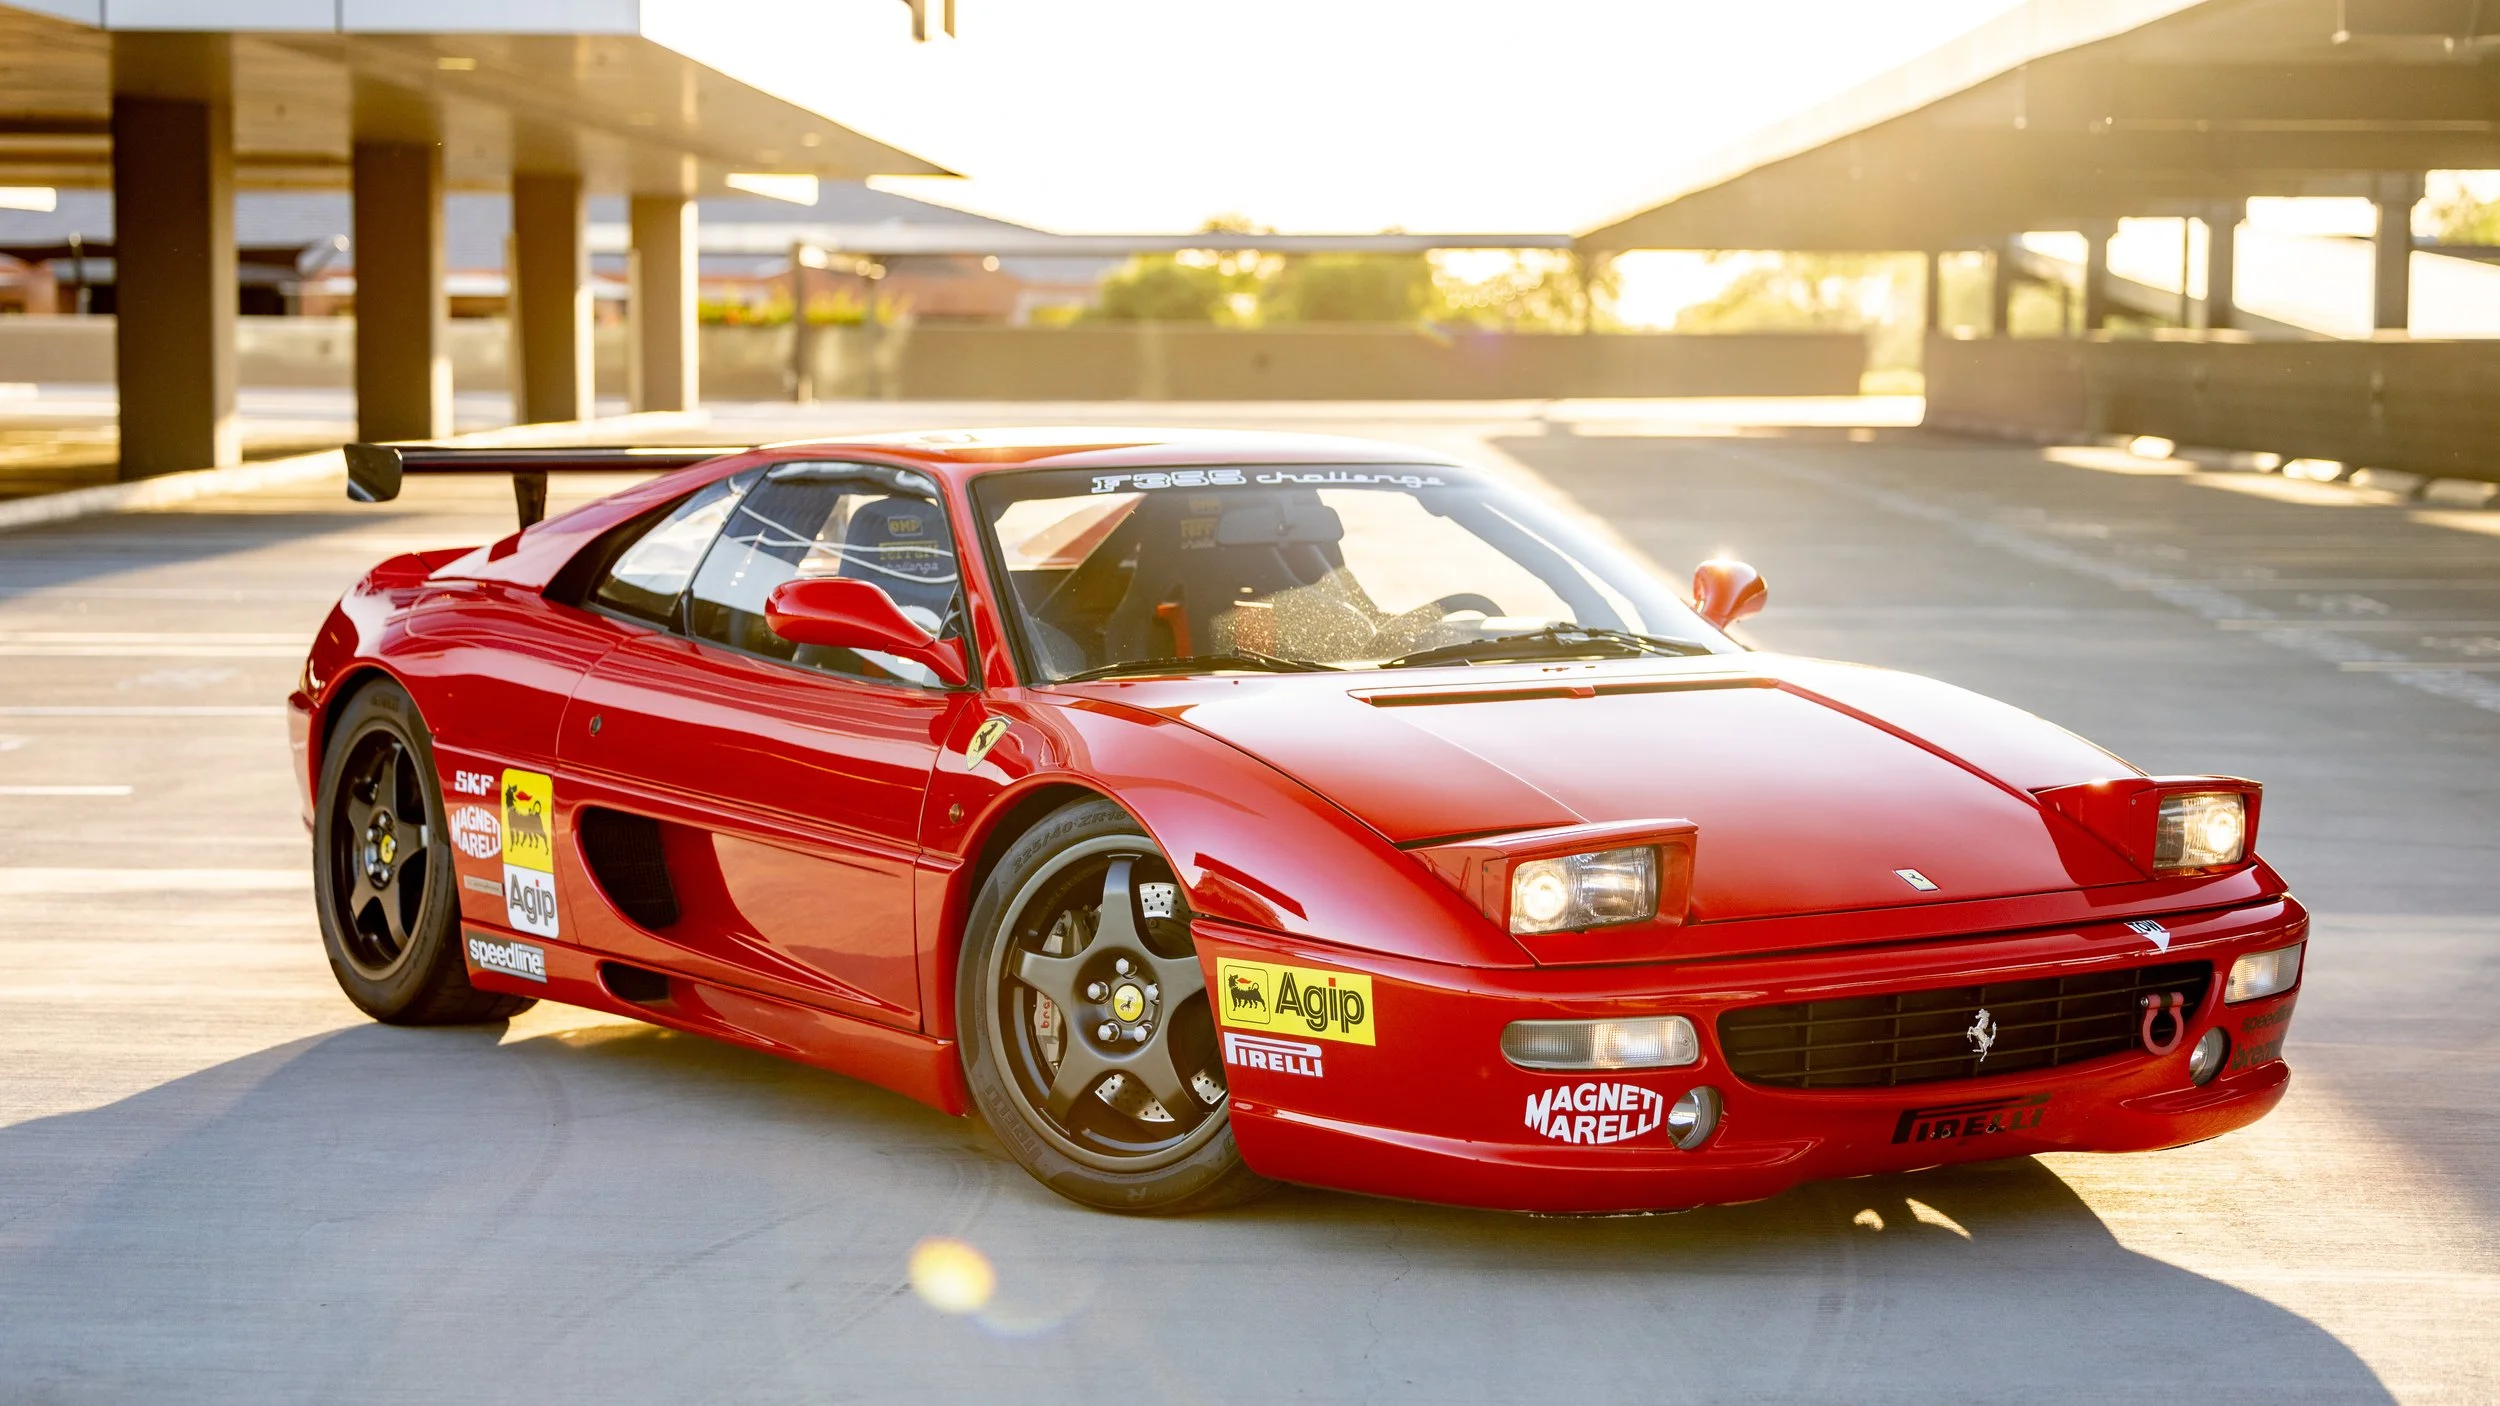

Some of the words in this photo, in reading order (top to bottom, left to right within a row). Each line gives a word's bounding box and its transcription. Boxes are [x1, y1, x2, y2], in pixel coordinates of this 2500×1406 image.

[1091, 469, 1247, 493] F355
[1256, 471, 1445, 488] challenge
[454, 770, 494, 796] SKF
[451, 806, 501, 838] MAGNETI
[451, 825, 501, 859] MARELLI
[509, 873, 555, 927] Agip
[2127, 921, 2162, 932] TOW
[469, 938, 545, 975] speedline
[1275, 972, 1365, 1033] Agip
[1223, 1032, 1324, 1078] PIRELLI
[1525, 1083, 1663, 1120] MAGNETI
[1891, 1092, 2053, 1144] PIRELLI
[1525, 1107, 1663, 1145] MARELLI
